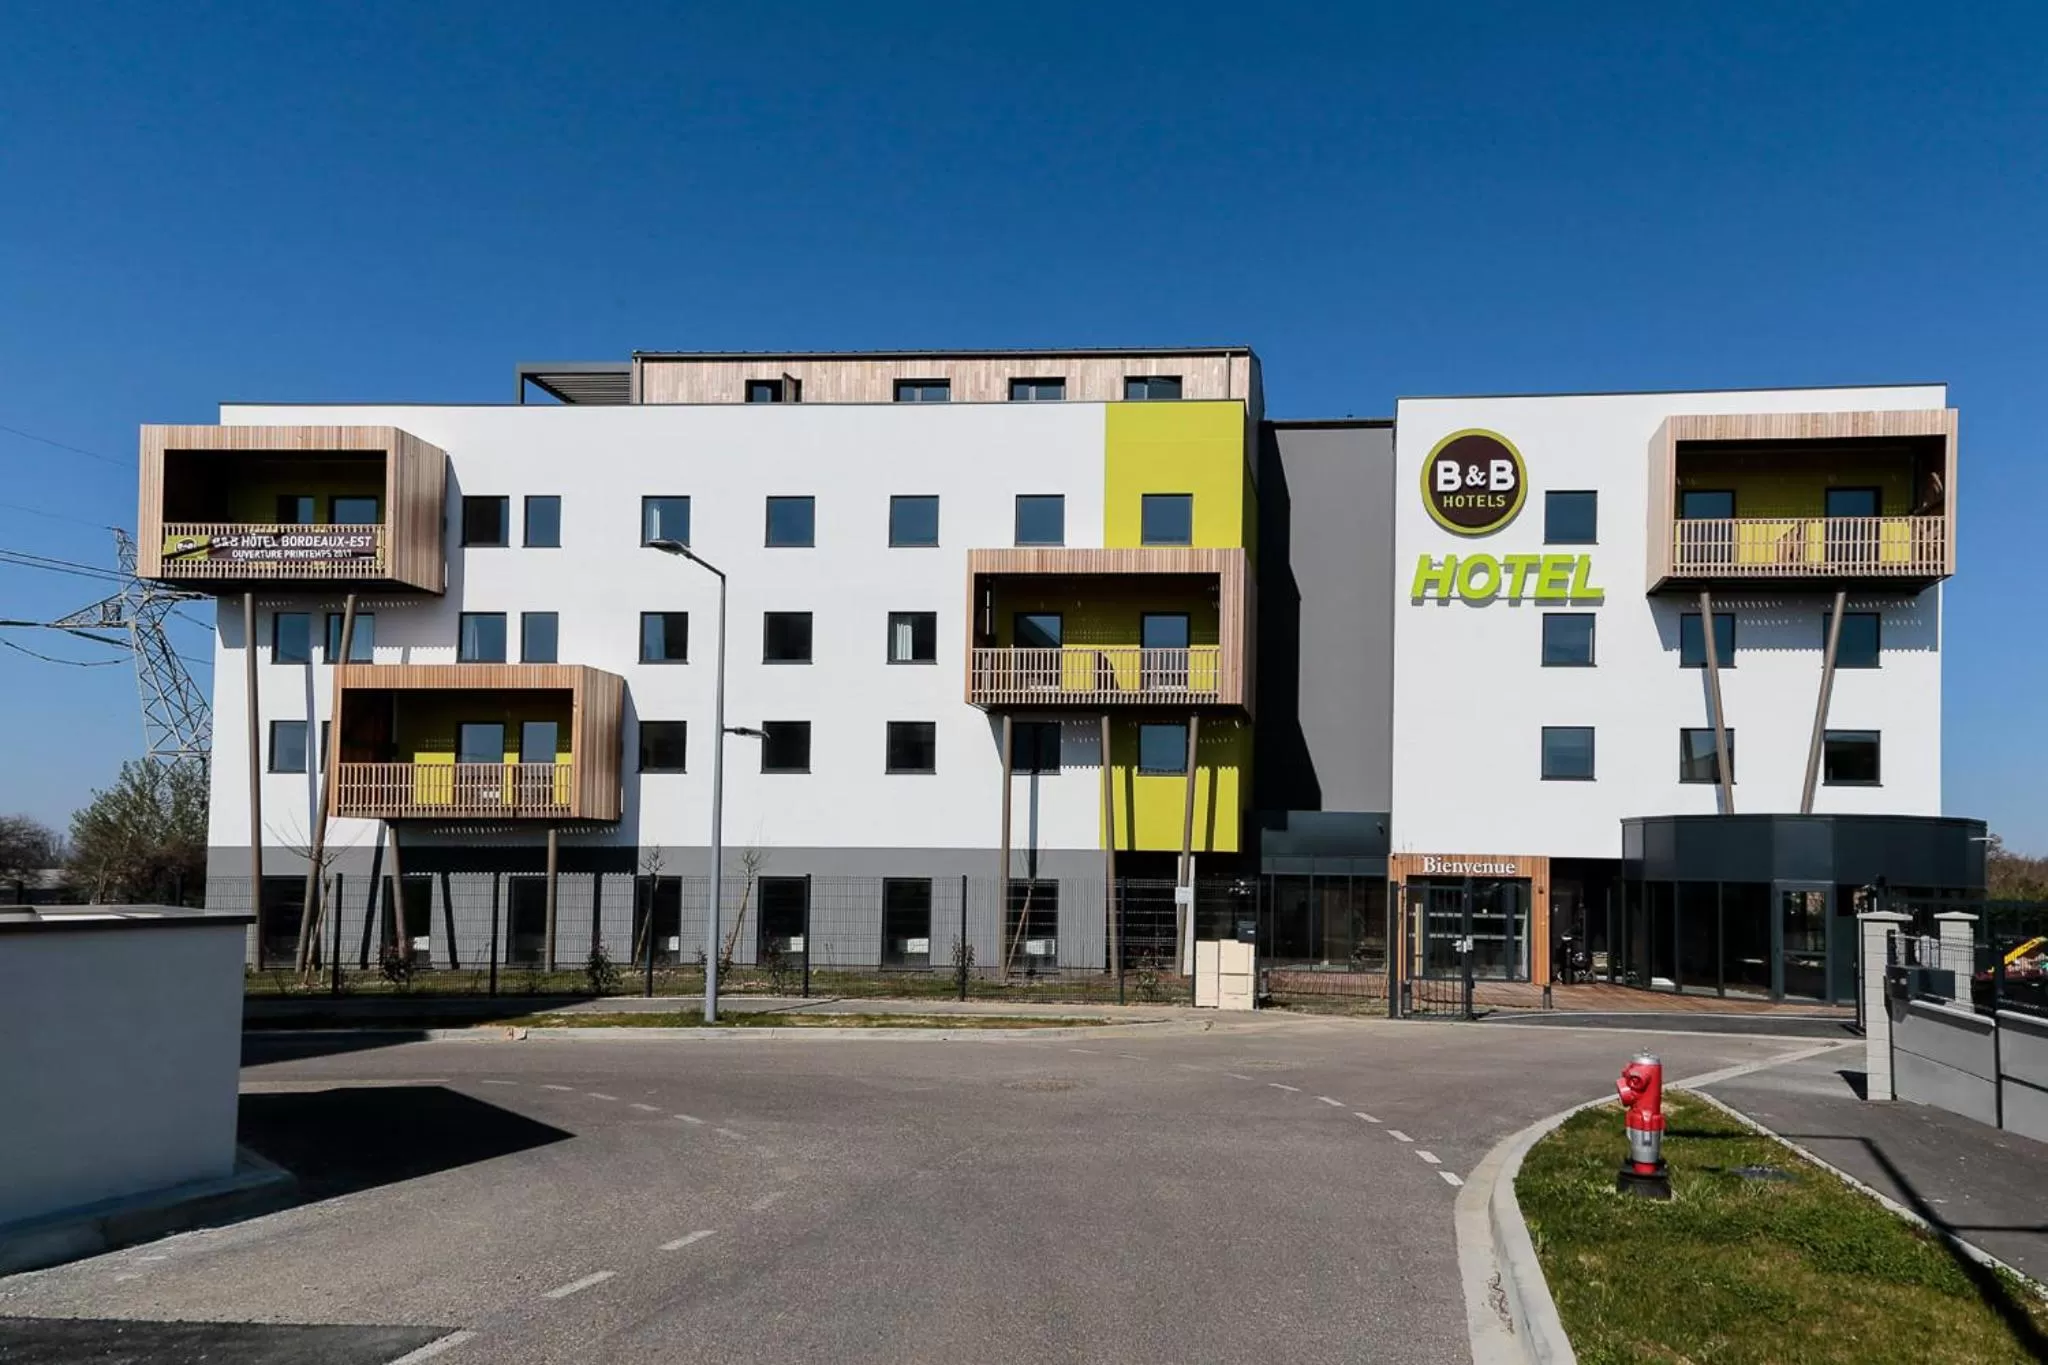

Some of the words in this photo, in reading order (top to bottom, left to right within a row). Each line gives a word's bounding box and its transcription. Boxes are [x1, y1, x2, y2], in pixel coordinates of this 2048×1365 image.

[1437, 459, 1515, 492] B&B
[1443, 494, 1506, 508] HOTELS
[241, 533, 278, 547] HÔTEL
[281, 535, 372, 547] BORDEAUX-EST
[232, 549, 282, 559] OUVERTURE
[284, 549, 332, 558] PRINTEMPS
[1410, 553, 1605, 601] HOTEL
[1423, 856, 1516, 874] Bienvenue
